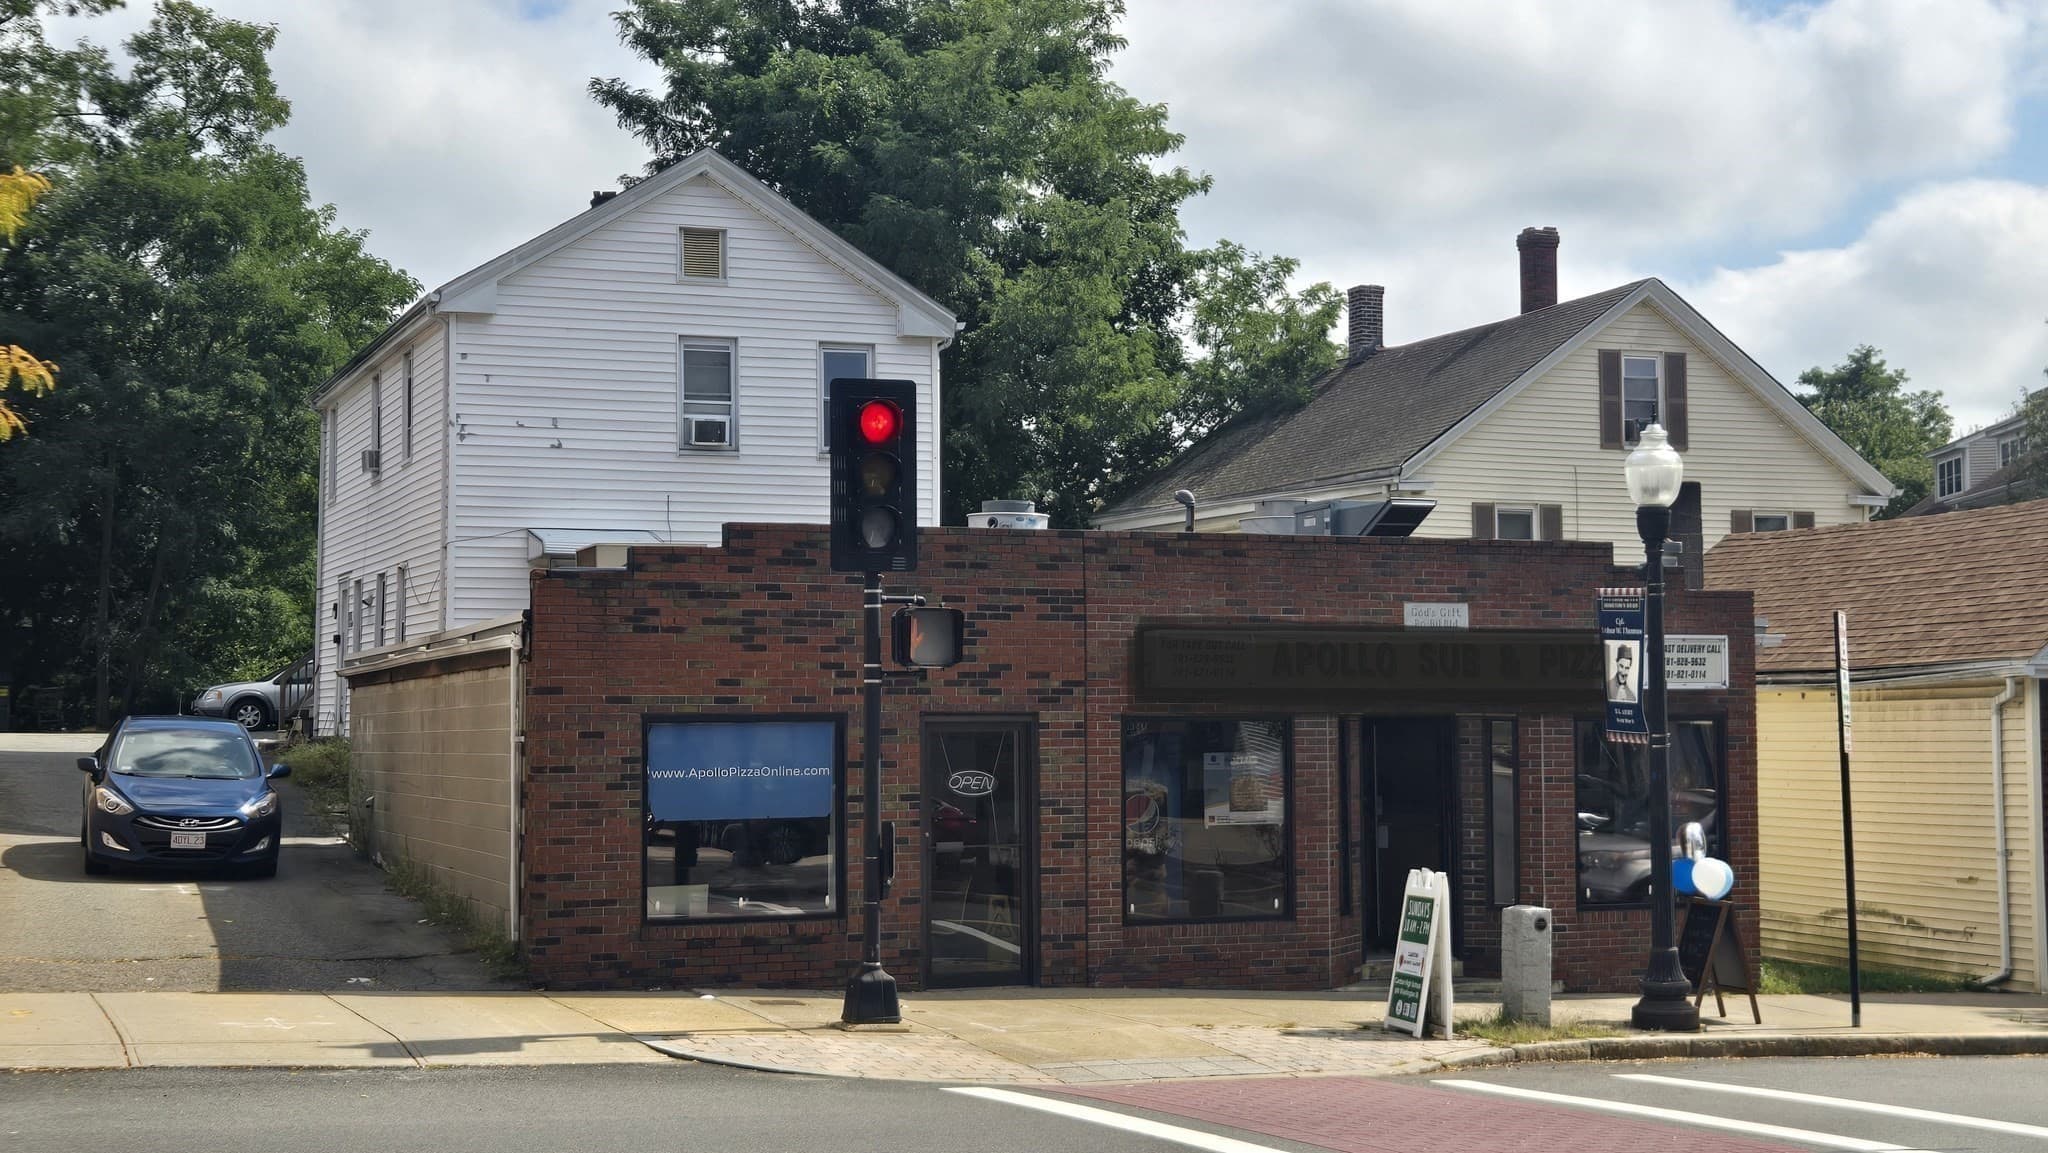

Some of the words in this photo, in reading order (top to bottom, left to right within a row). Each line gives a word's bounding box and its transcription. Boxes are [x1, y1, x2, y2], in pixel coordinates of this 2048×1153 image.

[1676, 644, 1706, 653] DELIVERY
[1706, 644, 1721, 653] CALL
[1272, 642, 1393, 678] APOLLO
[1419, 642, 1481, 679] SUB
[651, 764, 830, 779] www.ApolloPizzaOnline.com
[948, 775, 994, 789] OPEN
[1408, 900, 1431, 918] SUNDAYS
